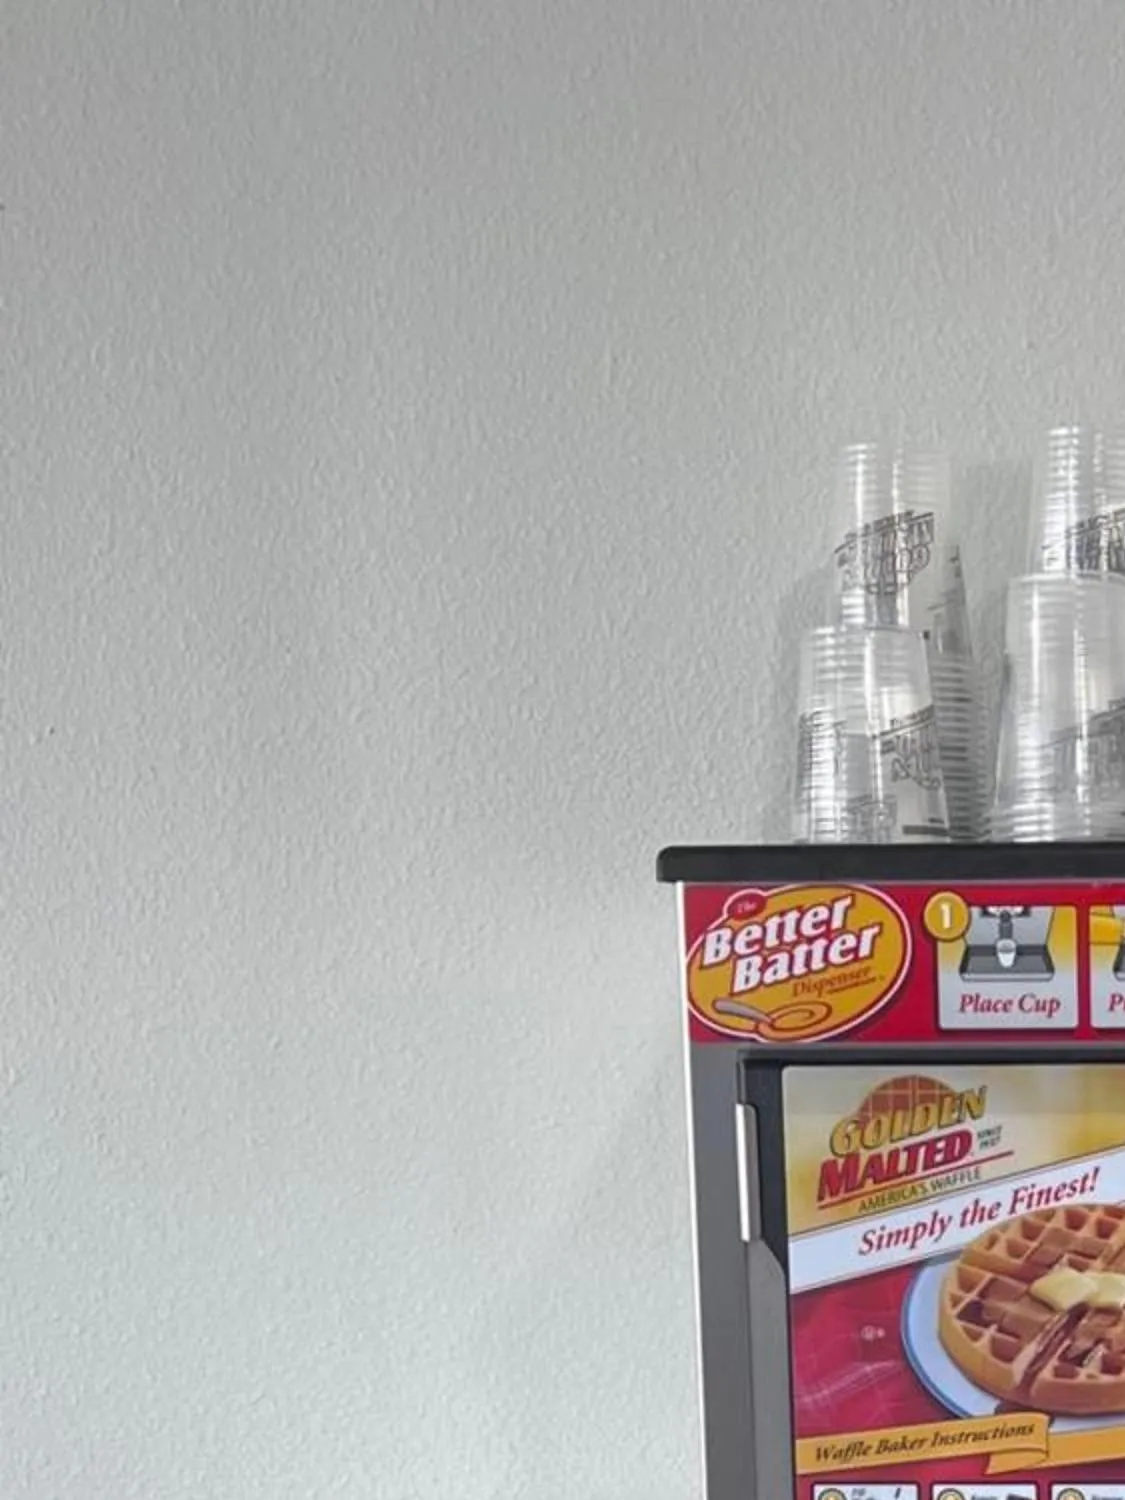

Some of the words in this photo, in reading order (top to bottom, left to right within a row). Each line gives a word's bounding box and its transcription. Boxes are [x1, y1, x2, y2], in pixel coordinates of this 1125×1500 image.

[736, 900, 758, 913] The
[940, 904, 951, 929] 1
[702, 895, 854, 967] Better
[732, 924, 881, 994] Batter
[792, 966, 872, 997] Dispenser
[958, 992, 1013, 1014] Place
[1018, 992, 1061, 1017] Cup
[830, 1085, 988, 1157] GOLDEN
[817, 1128, 973, 1203] MALTED
[858, 1181, 929, 1213] AMERICA'S
[930, 1167, 981, 1192] WAFFLE
[858, 1208, 953, 1256] Simply
[959, 1197, 1002, 1229] the
[1008, 1166, 1100, 1216] Finest!
[815, 1440, 874, 1464] Waffle
[875, 1434, 929, 1455] Baker
[931, 1422, 1035, 1448] Instructions
